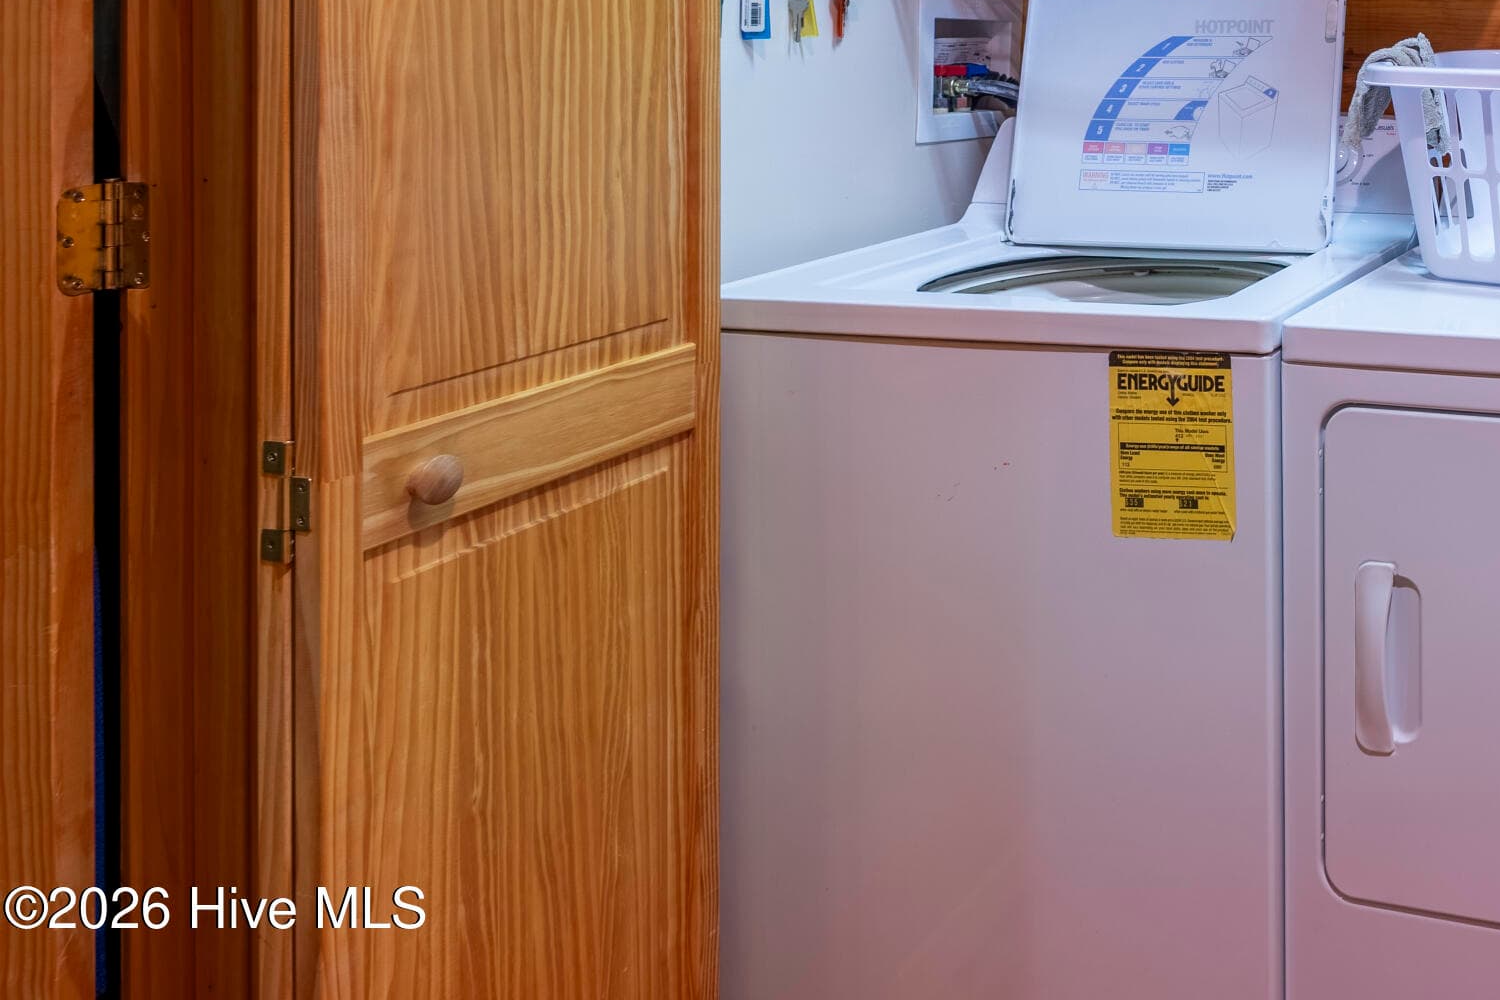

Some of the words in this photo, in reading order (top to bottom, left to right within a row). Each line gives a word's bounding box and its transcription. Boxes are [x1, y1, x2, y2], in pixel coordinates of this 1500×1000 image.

[1195, 19, 1275, 34] HOTPOINT
[1136, 63, 1146, 72] 2
[1119, 83, 1128, 93] 3
[1106, 104, 1113, 113] 4
[1096, 125, 1103, 135] 5
[1117, 372, 1226, 392] ENERGYGUIDE
